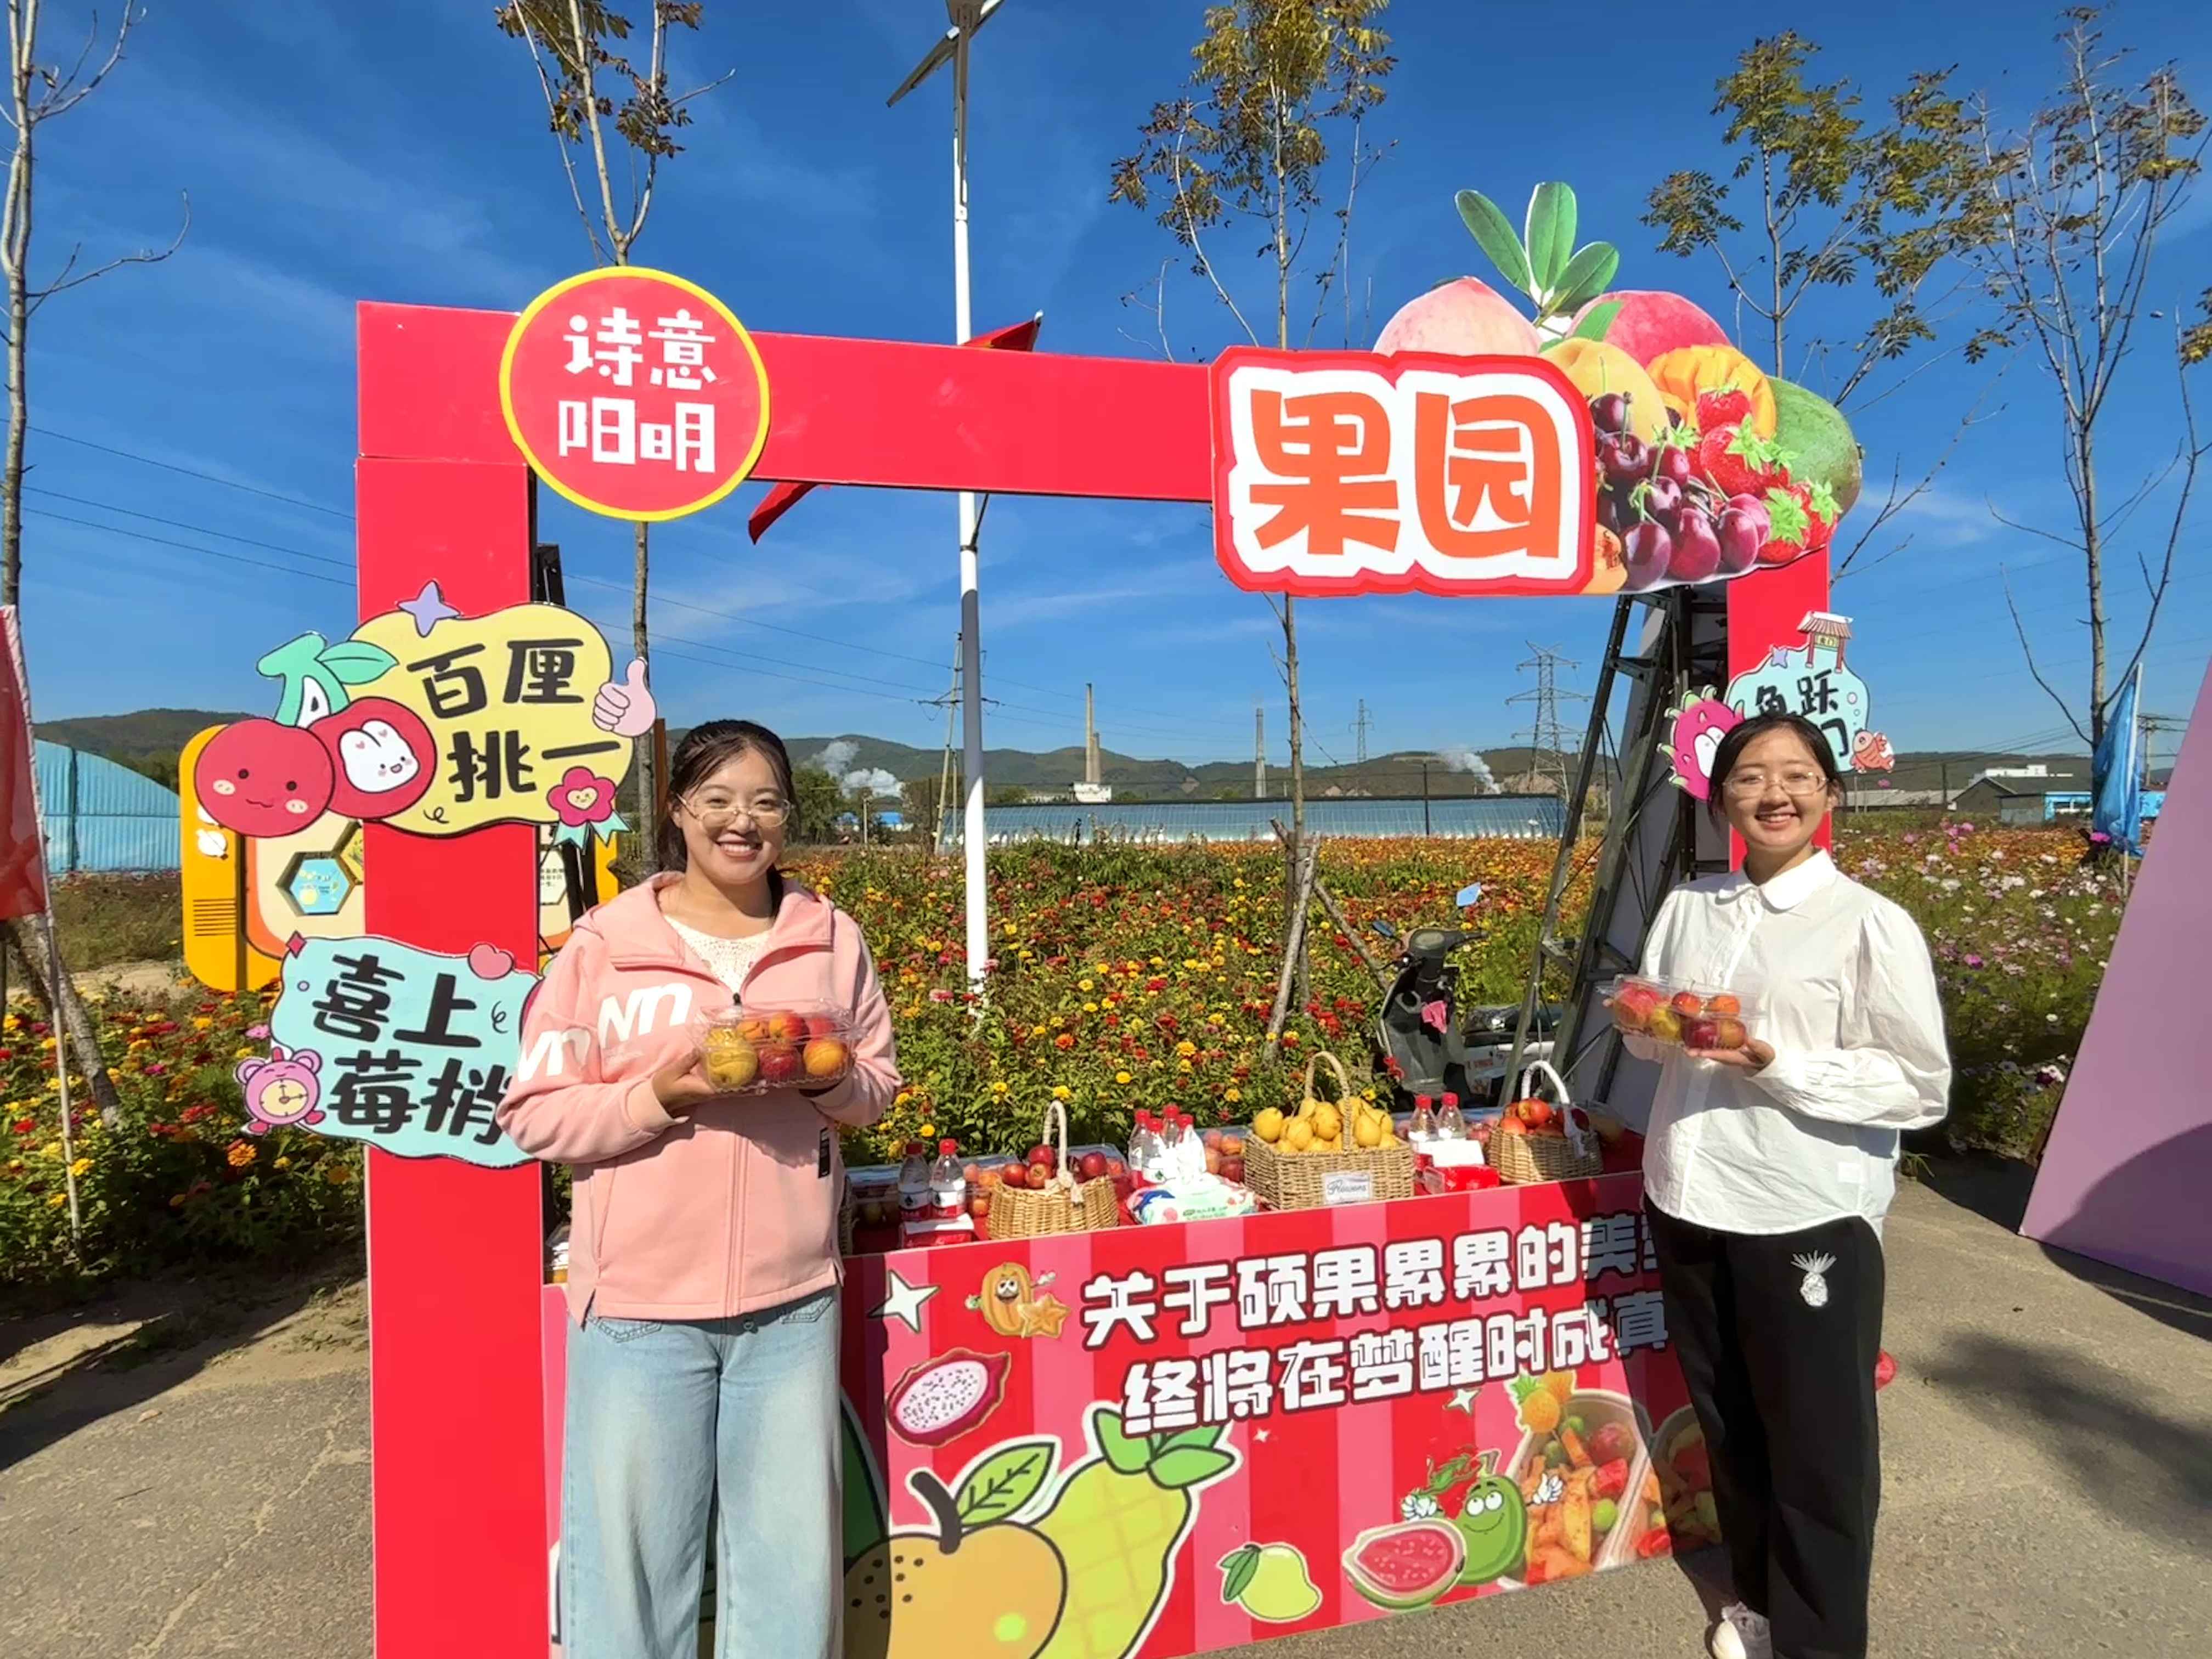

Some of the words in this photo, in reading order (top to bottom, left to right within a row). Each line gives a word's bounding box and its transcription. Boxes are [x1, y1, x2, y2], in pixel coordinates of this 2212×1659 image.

[562, 307, 718, 391] 诗意
[558, 397, 716, 473] 阳明
[1249, 388, 1562, 558] 果园
[407, 638, 584, 719] 百厘
[447, 730, 621, 803] 挑一
[312, 954, 482, 1048] 喜上
[329, 1049, 512, 1146] 莓梢
[1085, 1213, 1658, 1347] 关于硕果累累的美
[1125, 1290, 1669, 1433] 终将在梦醒时成真
